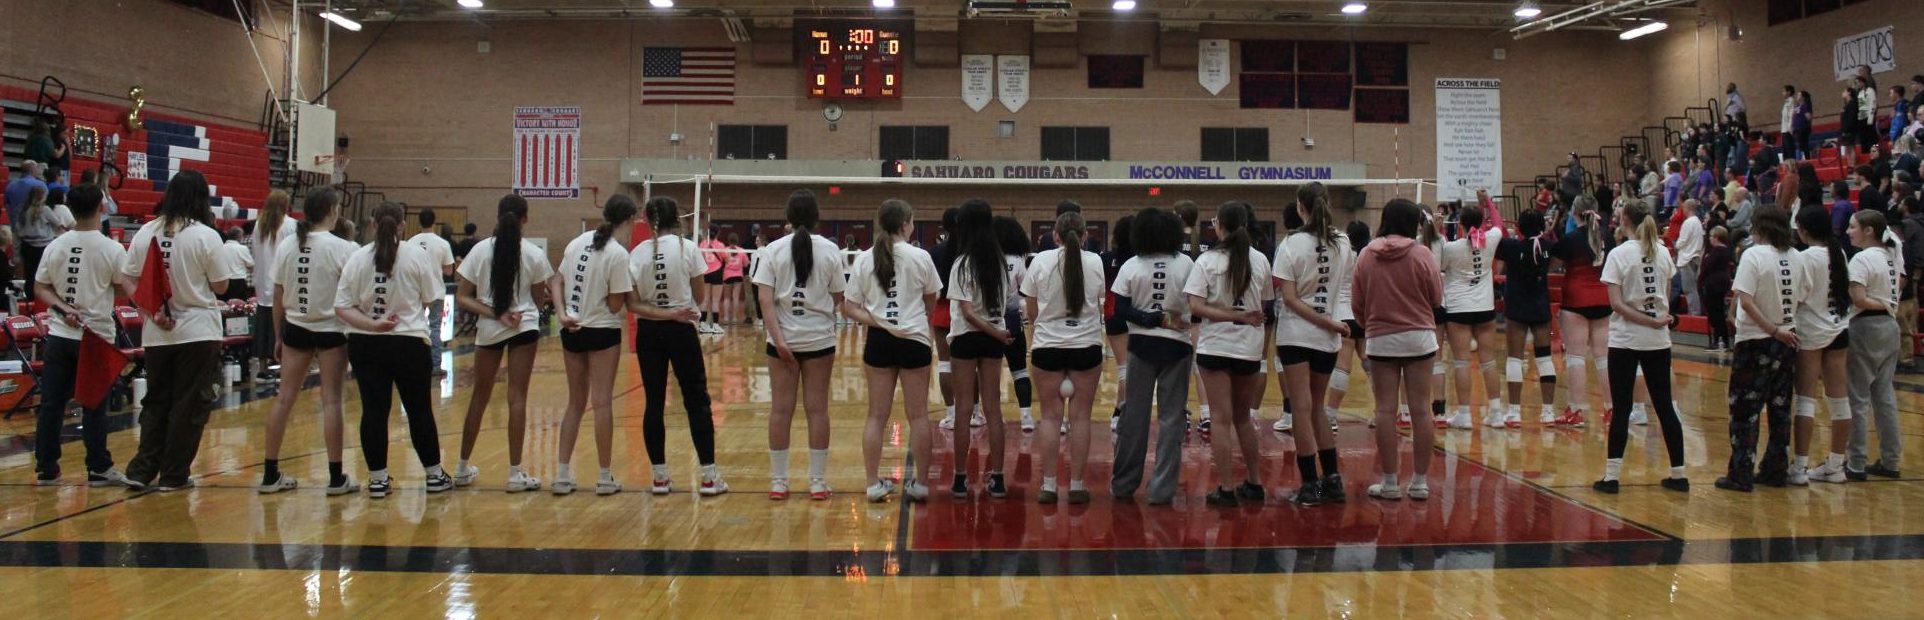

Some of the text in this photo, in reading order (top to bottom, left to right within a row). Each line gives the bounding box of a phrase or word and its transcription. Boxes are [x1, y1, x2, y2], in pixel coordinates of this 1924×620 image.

[820, 40, 829, 54] 0
[889, 40, 898, 54] 0
[1835, 30, 1892, 71] VISITORS
[817, 74, 825, 86] 0
[886, 74, 894, 86] 0
[517, 120, 539, 128] VICTORY
[541, 120, 556, 128] WITH
[911, 165, 995, 179] SAHUARO
[1003, 165, 1089, 179] COUGARS
[1129, 165, 1331, 180] McCONNELL GYMNASIUM
[518, 189, 572, 198] CHARACTER COUNTS
[64, 246, 83, 304] COUGAR
[298, 246, 311, 314] COUGARS
[1779, 259, 1793, 324] COUGARS
